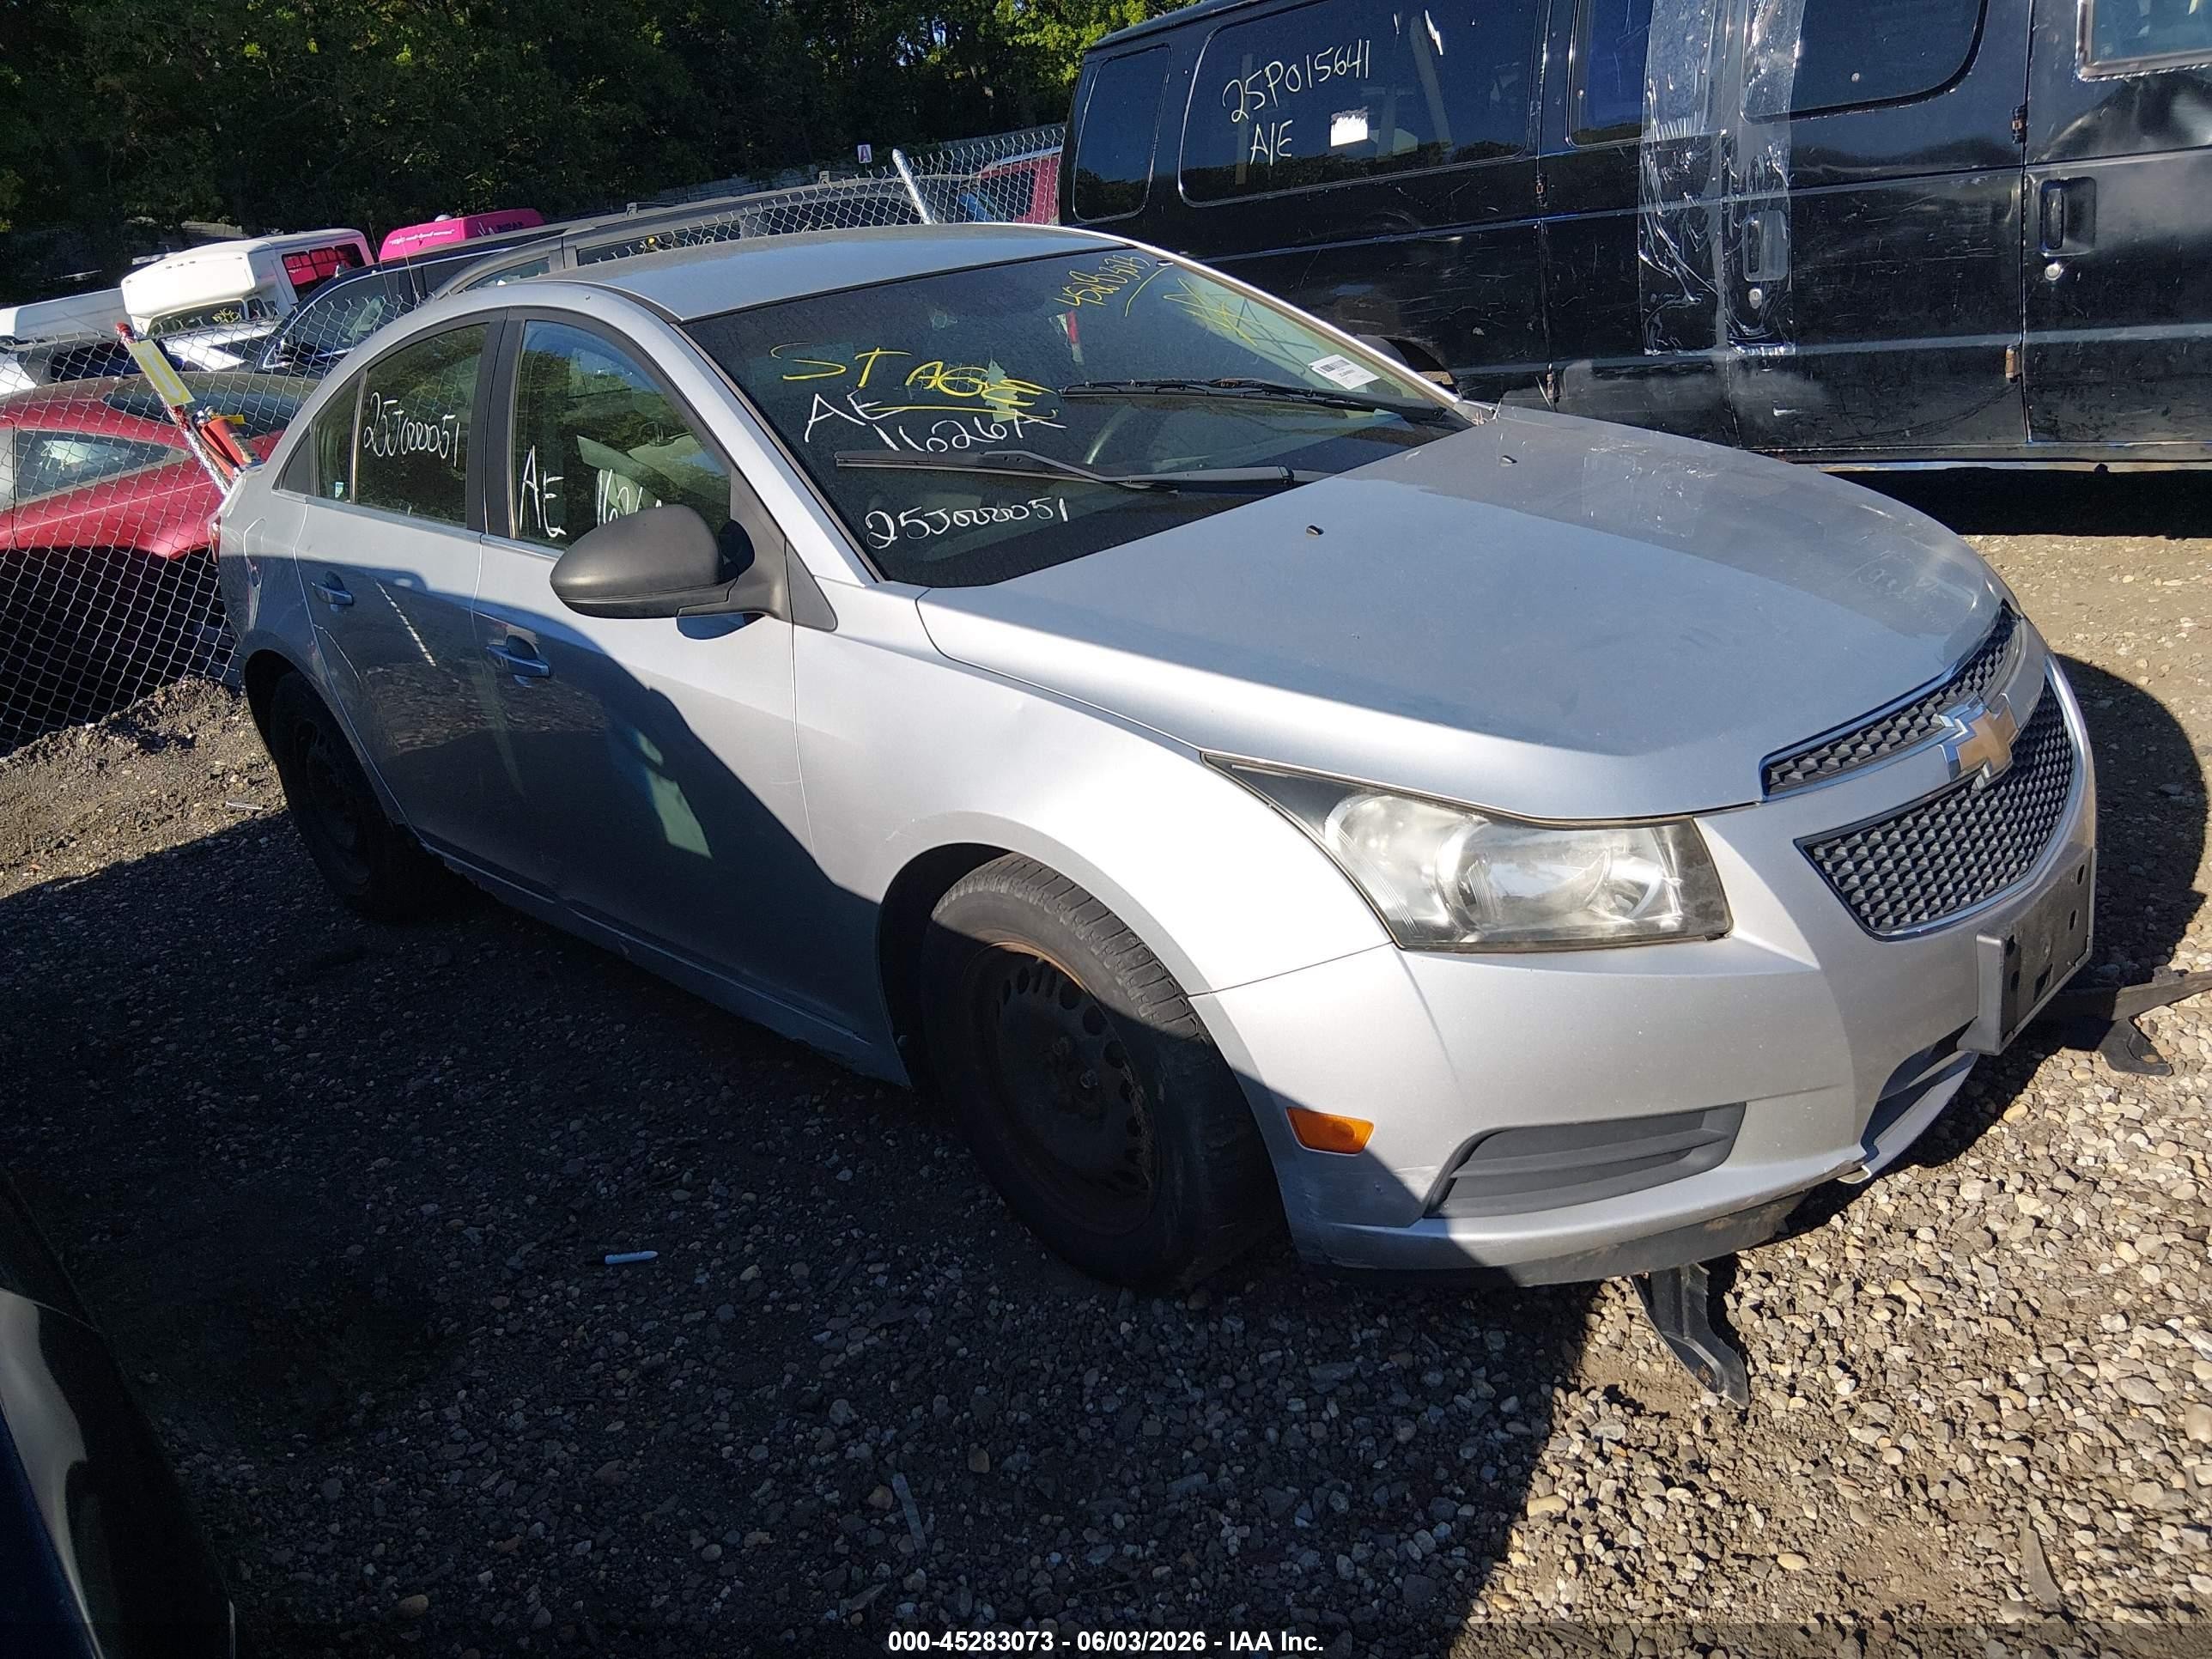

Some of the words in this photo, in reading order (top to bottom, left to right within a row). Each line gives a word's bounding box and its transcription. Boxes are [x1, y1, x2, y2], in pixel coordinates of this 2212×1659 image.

[1222, 39, 1370, 123] 25P015641
[860, 145, 871, 162] A
[363, 392, 460, 468] 25J000051
[804, 388, 905, 443] AE
[520, 445, 567, 538] AE
[865, 496, 1070, 550] 25J000051
